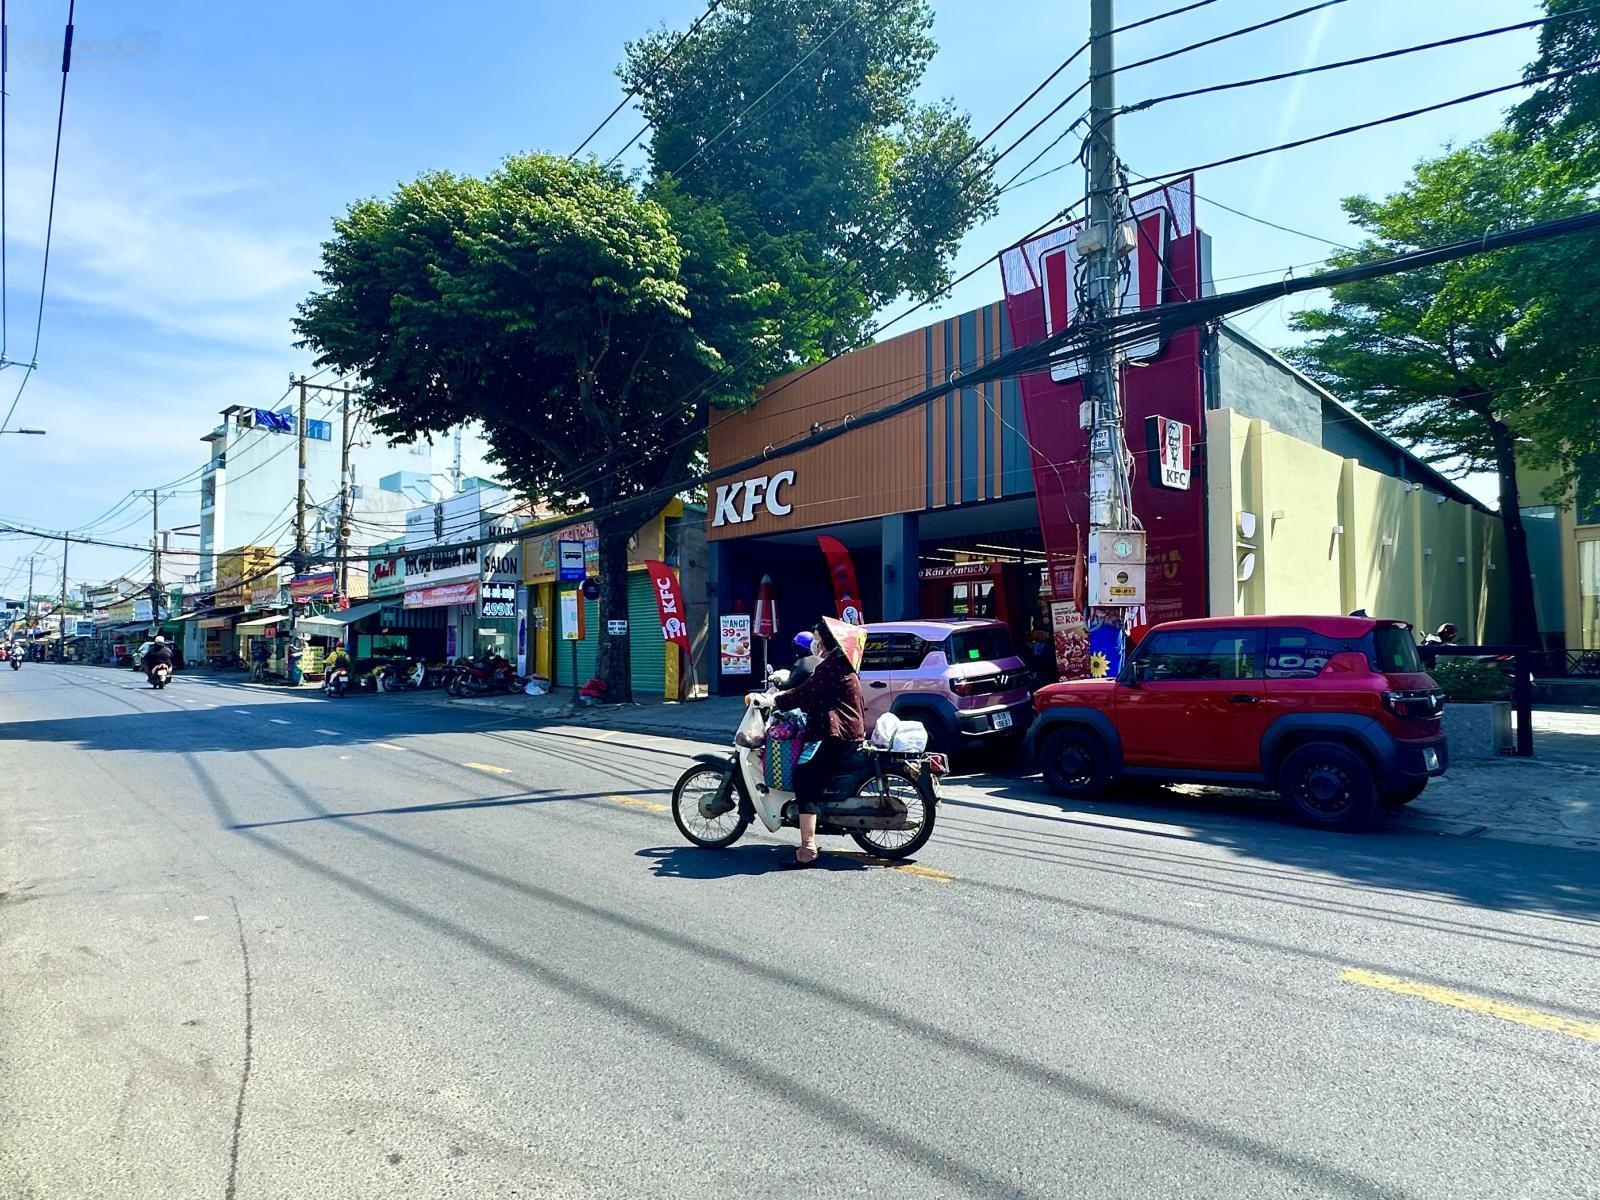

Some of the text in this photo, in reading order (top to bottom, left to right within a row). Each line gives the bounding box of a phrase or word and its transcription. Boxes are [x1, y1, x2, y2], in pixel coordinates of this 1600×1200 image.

[1166, 469, 1187, 486] KFC
[712, 470, 796, 527] KFC
[484, 556, 518, 574] SALON
[946, 564, 991, 576] Kentucky
[657, 577, 677, 614] KFC
[482, 602, 515, 616] 499K
